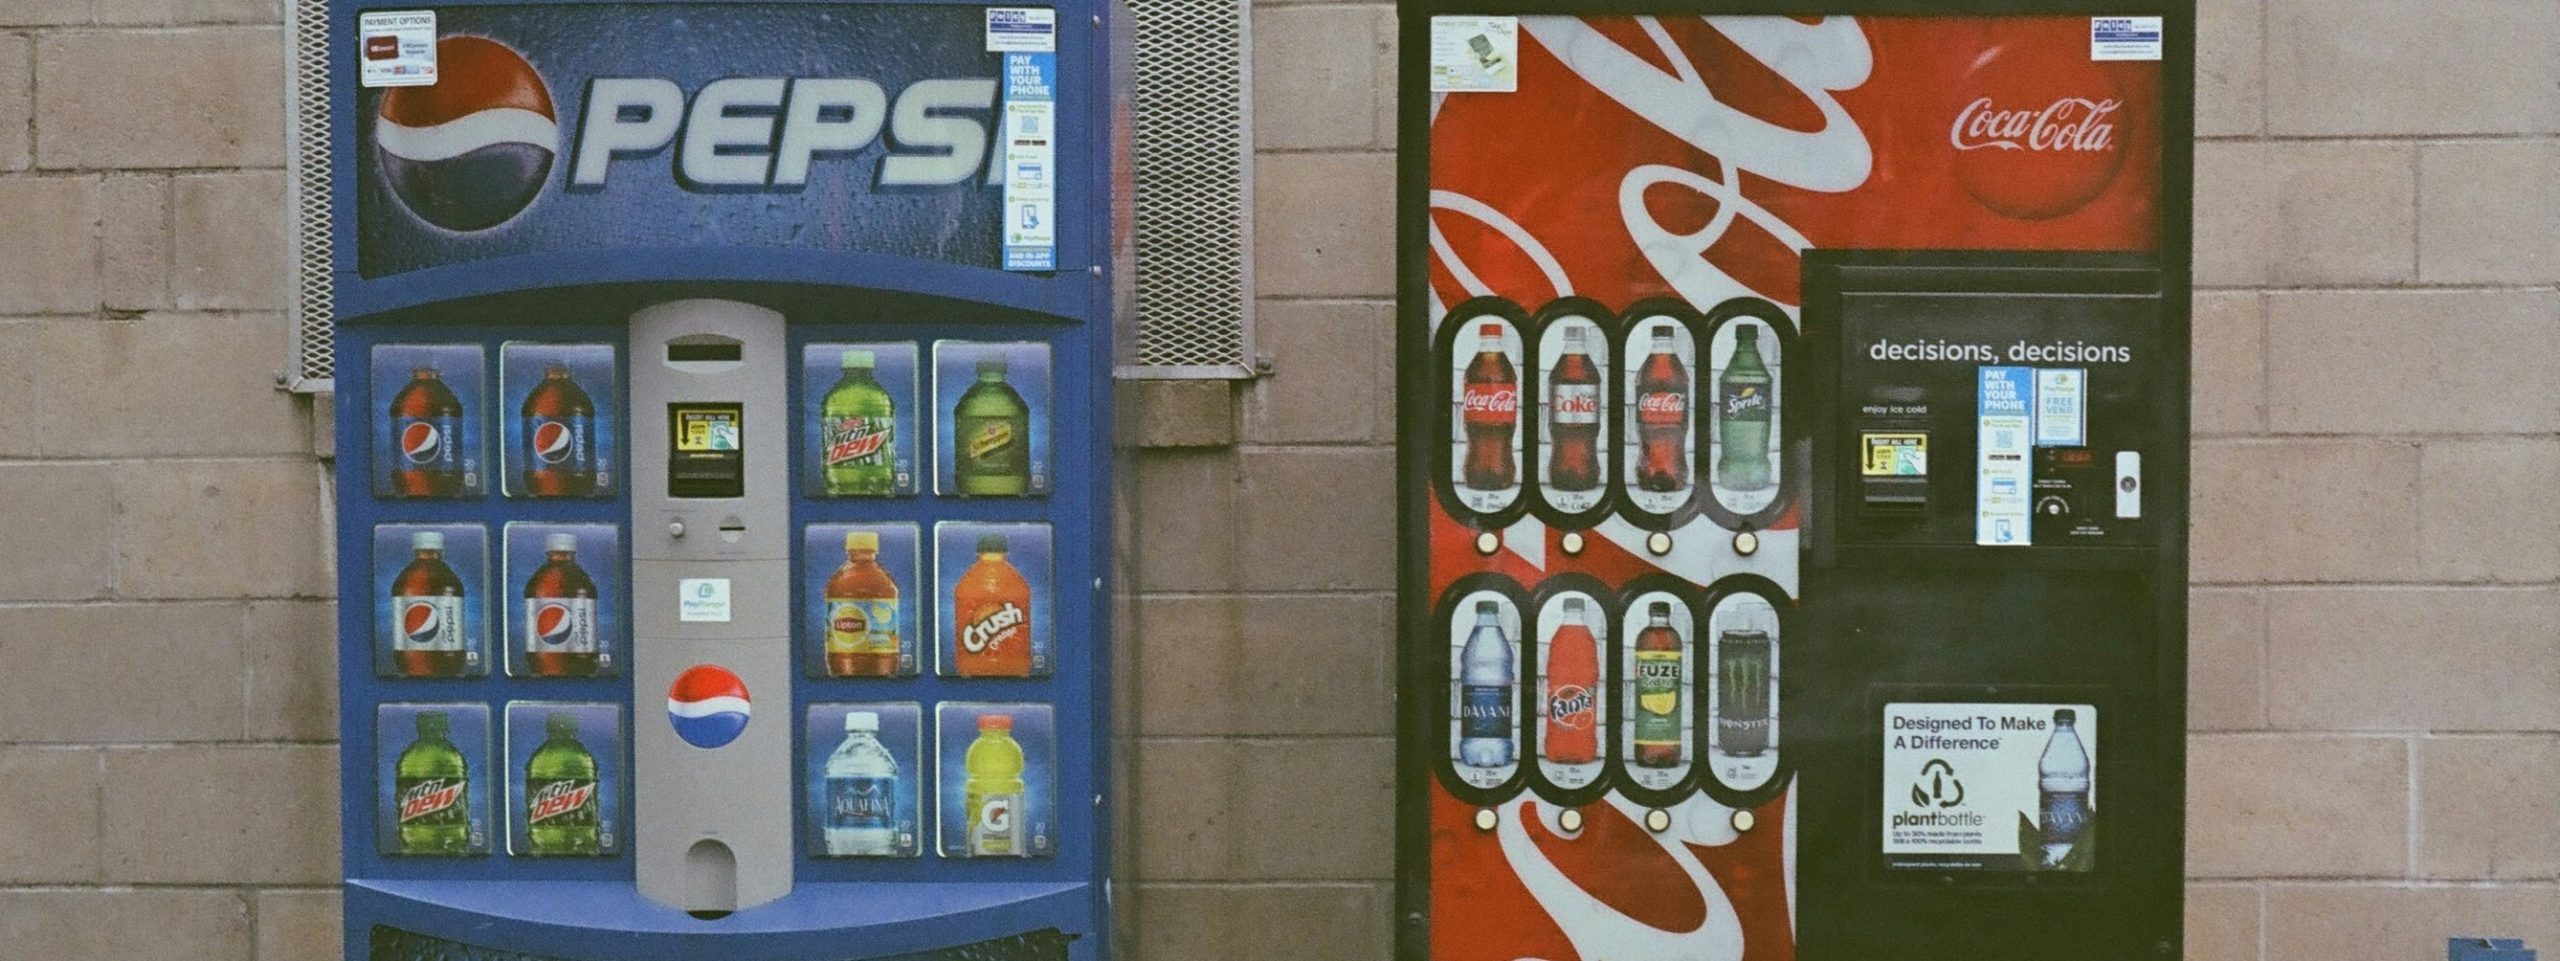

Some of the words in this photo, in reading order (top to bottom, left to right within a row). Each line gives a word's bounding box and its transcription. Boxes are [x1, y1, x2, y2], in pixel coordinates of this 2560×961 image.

[364, 17, 398, 26] PAYMENT
[399, 16, 432, 25] OPTIONS
[1010, 55, 1032, 65] PAY
[1010, 65, 1040, 75] WITH
[1010, 76, 1042, 85] YOUR
[1010, 86, 1050, 96] PHONE
[1951, 97, 2122, 151] Coca-Cola
[571, 78, 1004, 187] PEPS
[1869, 339, 1999, 364] decisions,
[2008, 340, 2131, 363] decisions
[1984, 370, 2007, 380] PAY
[1984, 380, 2015, 390] WITH
[1464, 389, 1517, 412] Coca-Cola
[1638, 392, 1686, 413] Coca-Cola
[1984, 391, 2017, 400] YOUR
[2047, 397, 2074, 406] FREE
[1553, 395, 1596, 413] Coke
[1727, 394, 1764, 415] Sprite
[1861, 405, 1888, 415] enjoy
[1890, 405, 1904, 413] ice
[1906, 404, 1928, 414] cold
[1984, 400, 2026, 410] PHONE
[2046, 406, 2074, 415] VEND
[441, 423, 454, 463] pepsi
[574, 423, 587, 462] pepsi
[963, 602, 1023, 653] Crush
[1639, 665, 1680, 678] FUZE
[1892, 716, 1972, 732] Designed
[1976, 716, 1996, 730] To
[2000, 716, 2046, 730] Make
[1893, 736, 1907, 750] A
[1911, 735, 2000, 750] Difference
[1892, 811, 1984, 829] plantbottle
